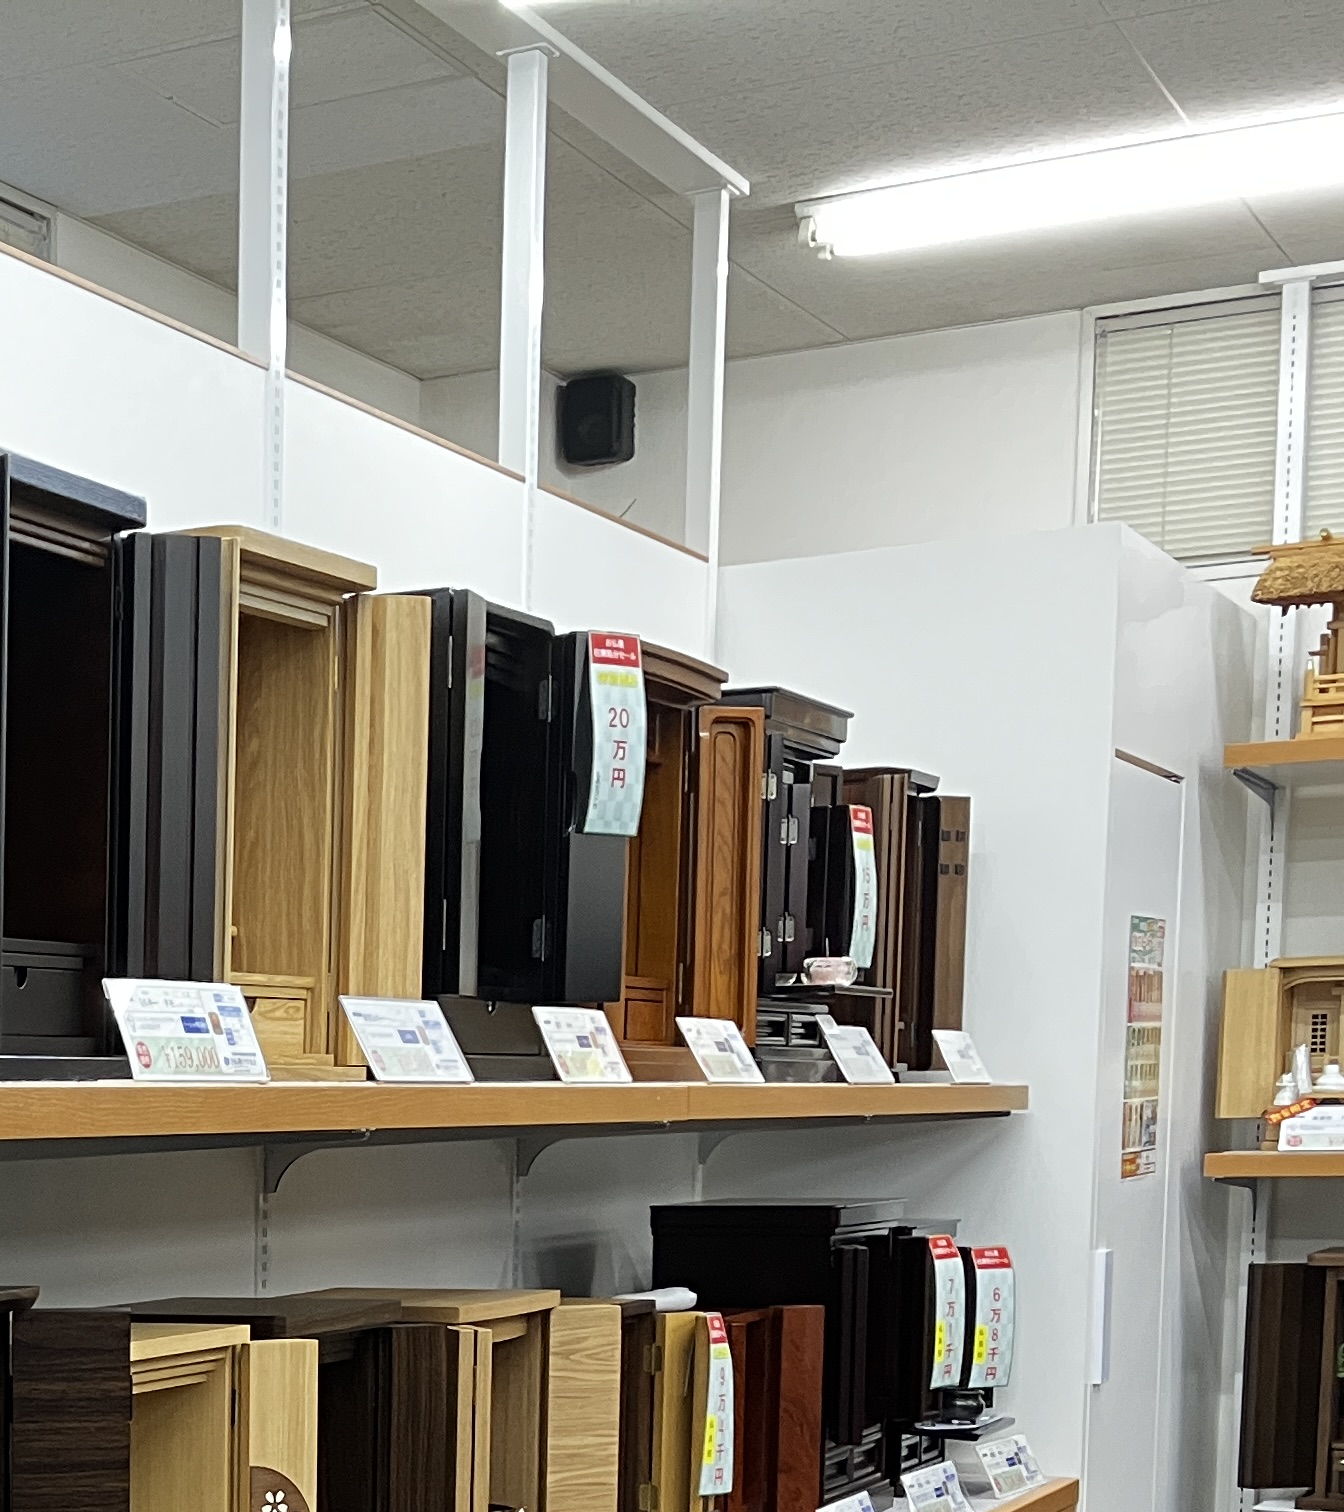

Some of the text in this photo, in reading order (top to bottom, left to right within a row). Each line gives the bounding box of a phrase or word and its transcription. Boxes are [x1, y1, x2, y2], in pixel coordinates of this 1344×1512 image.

[608, 706, 631, 790] 20万円
[984, 1286, 1002, 1382] 6万8千円
